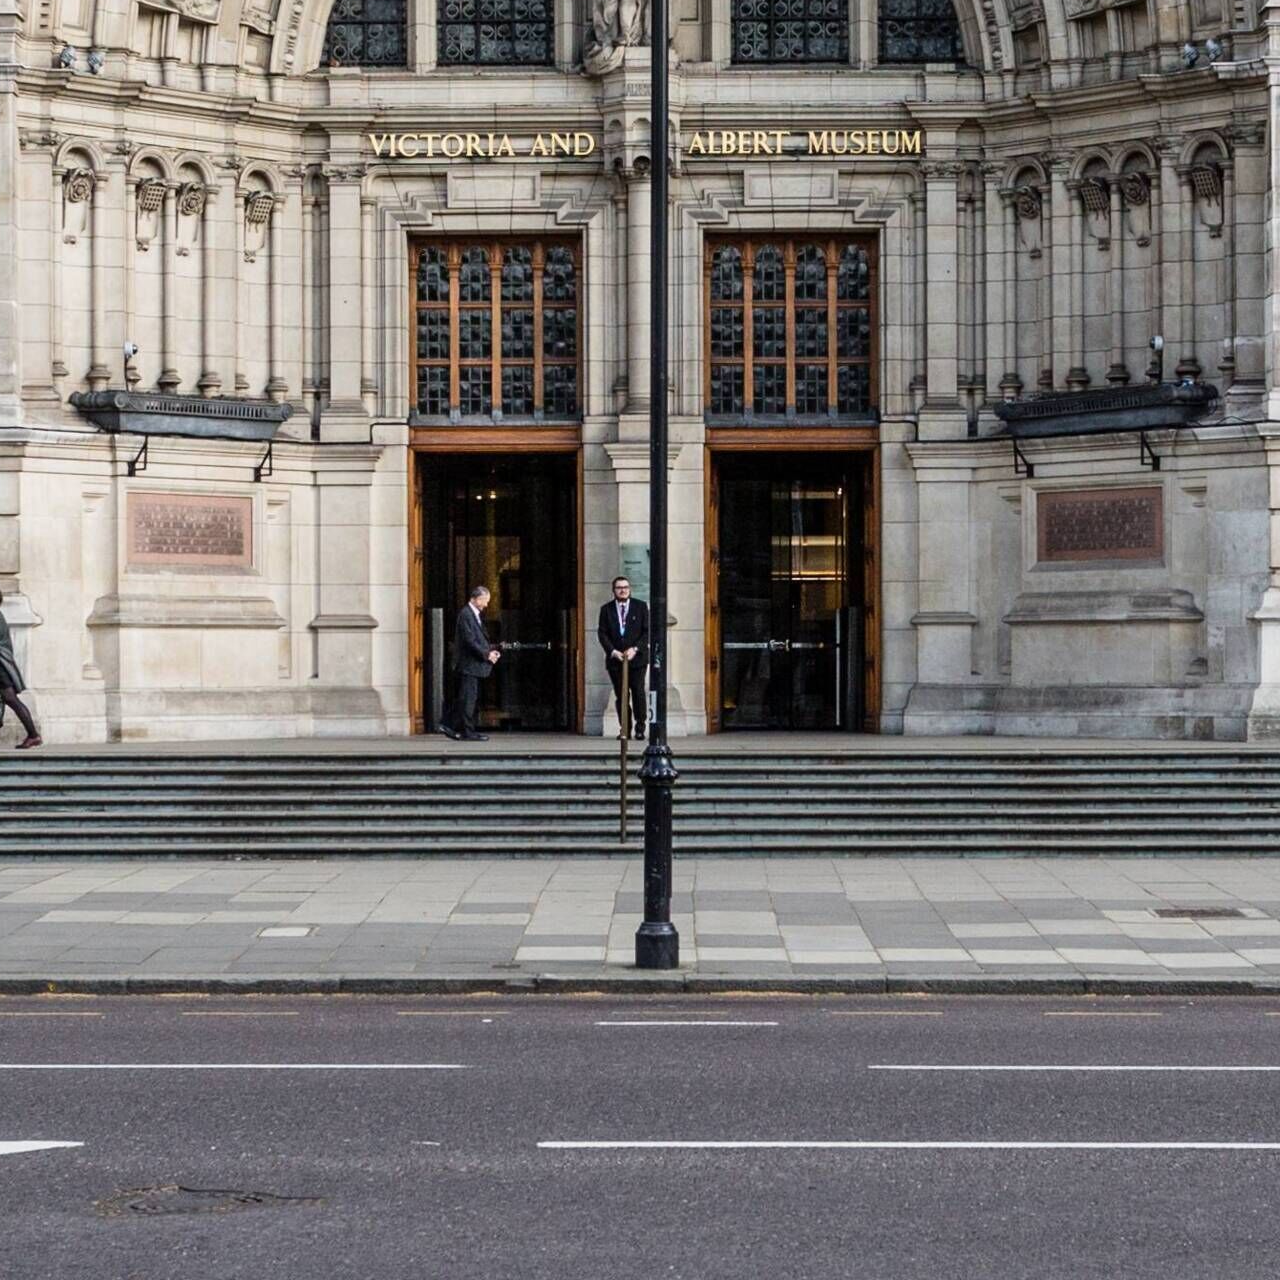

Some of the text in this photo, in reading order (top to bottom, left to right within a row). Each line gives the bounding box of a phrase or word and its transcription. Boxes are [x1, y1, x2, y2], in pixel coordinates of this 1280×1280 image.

[369, 133, 595, 157] VICTORIA AND
[688, 130, 922, 154] ALBERT MUSEUM
